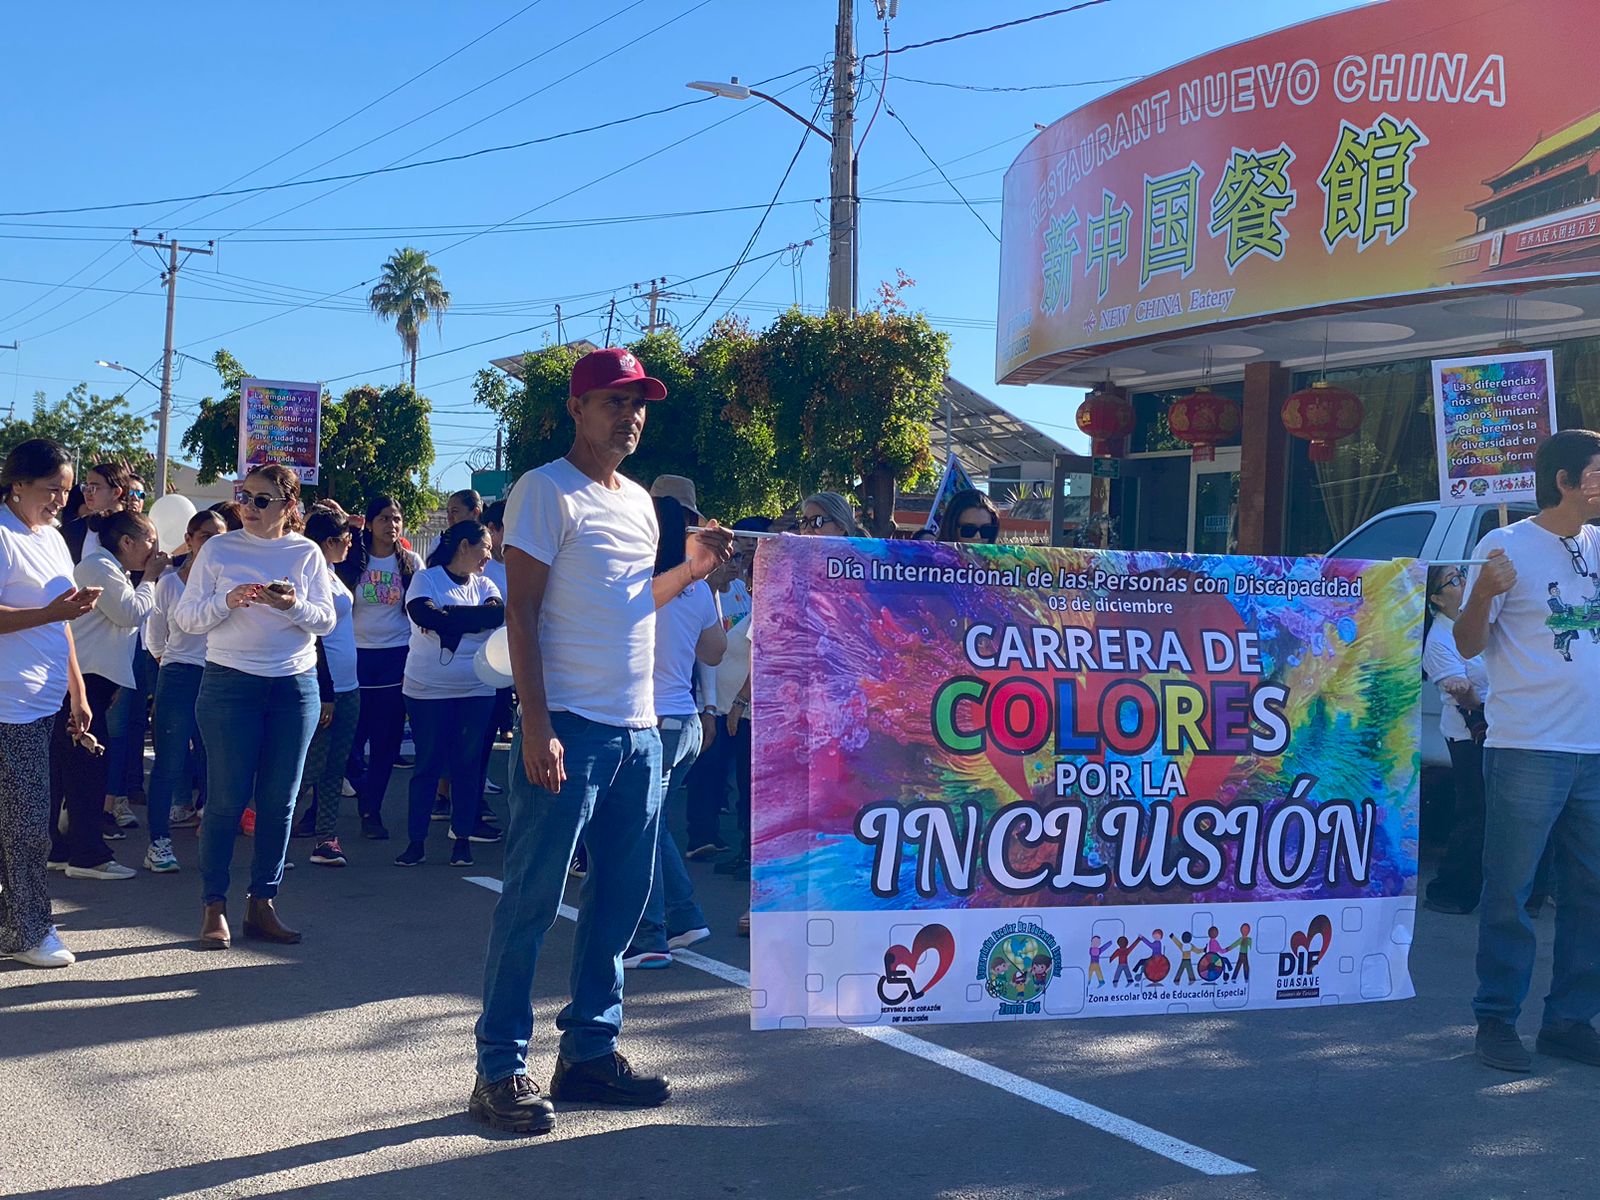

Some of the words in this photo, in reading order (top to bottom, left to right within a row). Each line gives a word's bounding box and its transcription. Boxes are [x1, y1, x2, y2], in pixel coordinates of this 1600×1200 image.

[1029, 89, 1171, 239] RESTAURANT
[1178, 58, 1320, 123] NUEVO
[1332, 52, 1507, 108] CHINA
[1099, 304, 1132, 331] NEW
[1135, 293, 1184, 324] CHINA
[1187, 287, 1236, 313] Eatery
[1453, 383, 1472, 392] Las
[1474, 376, 1537, 390] diferencias
[1451, 398, 1472, 407] nos
[1474, 391, 1540, 407] enriquecen,
[251, 413, 269, 422] para
[1455, 413, 1470, 421] no
[1472, 410, 1493, 420] nos
[1494, 406, 1538, 418] limitan.
[251, 423, 278, 431] mundo
[280, 425, 305, 433] donde
[305, 426, 312, 434] la
[1458, 422, 1525, 437] Celebremos
[1527, 420, 1537, 431] la
[254, 433, 294, 442] diversidad
[1462, 436, 1520, 451] diversidad
[1522, 437, 1537, 445] en
[296, 446, 307, 454] no
[1451, 455, 1482, 466] todas
[1485, 454, 1504, 463] sus
[1506, 451, 1534, 463] form
[826, 557, 866, 581] Día
[871, 559, 1022, 588] Internacional
[1026, 566, 1054, 588] de
[1058, 567, 1088, 590] las
[1092, 570, 1189, 594] Personas
[1193, 575, 1230, 595] con
[1233, 574, 1363, 601] Discapacidad
[1047, 595, 1069, 613] 03
[1070, 596, 1092, 612] de
[1094, 597, 1174, 615] diciembre
[964, 624, 1193, 673] CARRERA
[1204, 630, 1263, 674] DE
[932, 677, 1290, 756] COLORES
[1055, 762, 1131, 797] POR
[1143, 763, 1187, 798] LA
[857, 777, 1376, 896] INCLUSIÓN
[1278, 950, 1319, 977] DIF
[1276, 976, 1320, 989] GUASAVE
[1088, 994, 1109, 1003] Zona
[1110, 992, 1140, 1002] escolar
[1142, 991, 1158, 1000] 024
[1160, 990, 1171, 1000] de
[1172, 989, 1215, 999] Educación
[1216, 987, 1247, 998] Especial
[999, 1002, 1025, 1015] Zona
